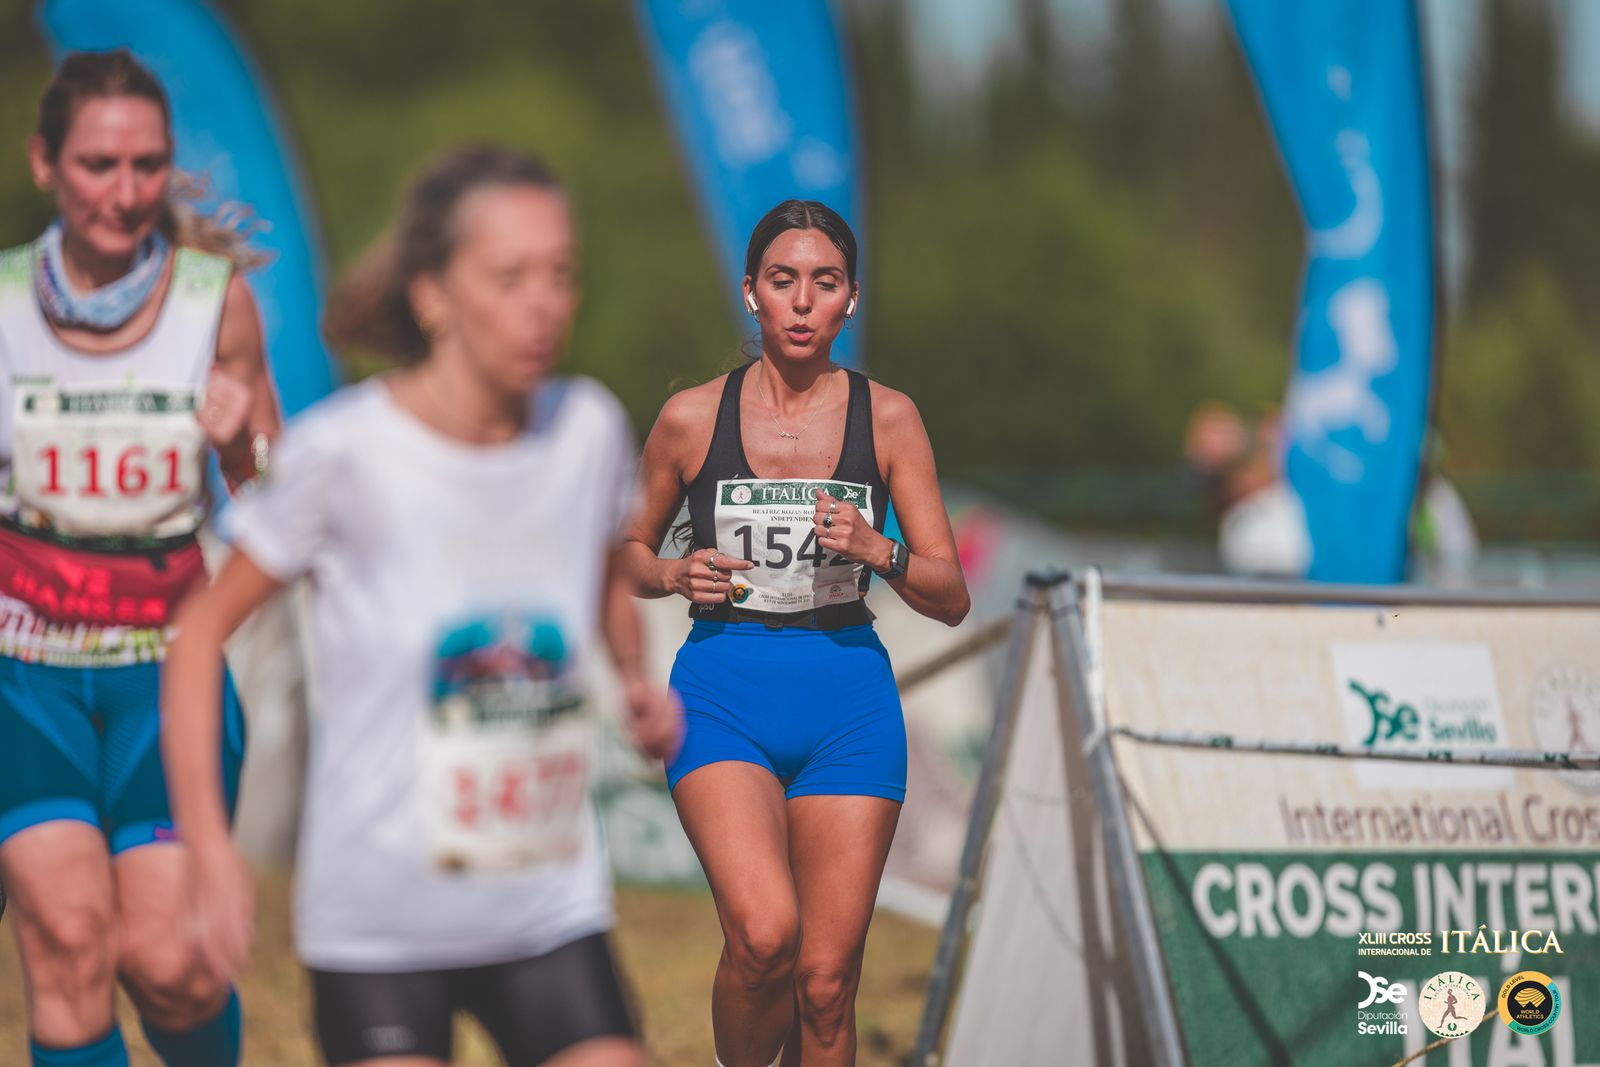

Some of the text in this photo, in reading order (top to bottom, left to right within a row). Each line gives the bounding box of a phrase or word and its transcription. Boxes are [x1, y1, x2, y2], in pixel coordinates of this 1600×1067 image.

[38, 443, 187, 498] 1161
[1429, 714, 1497, 744] Sevilla
[1278, 793, 1517, 845] International
[1191, 861, 1600, 939] CROSS INTER
